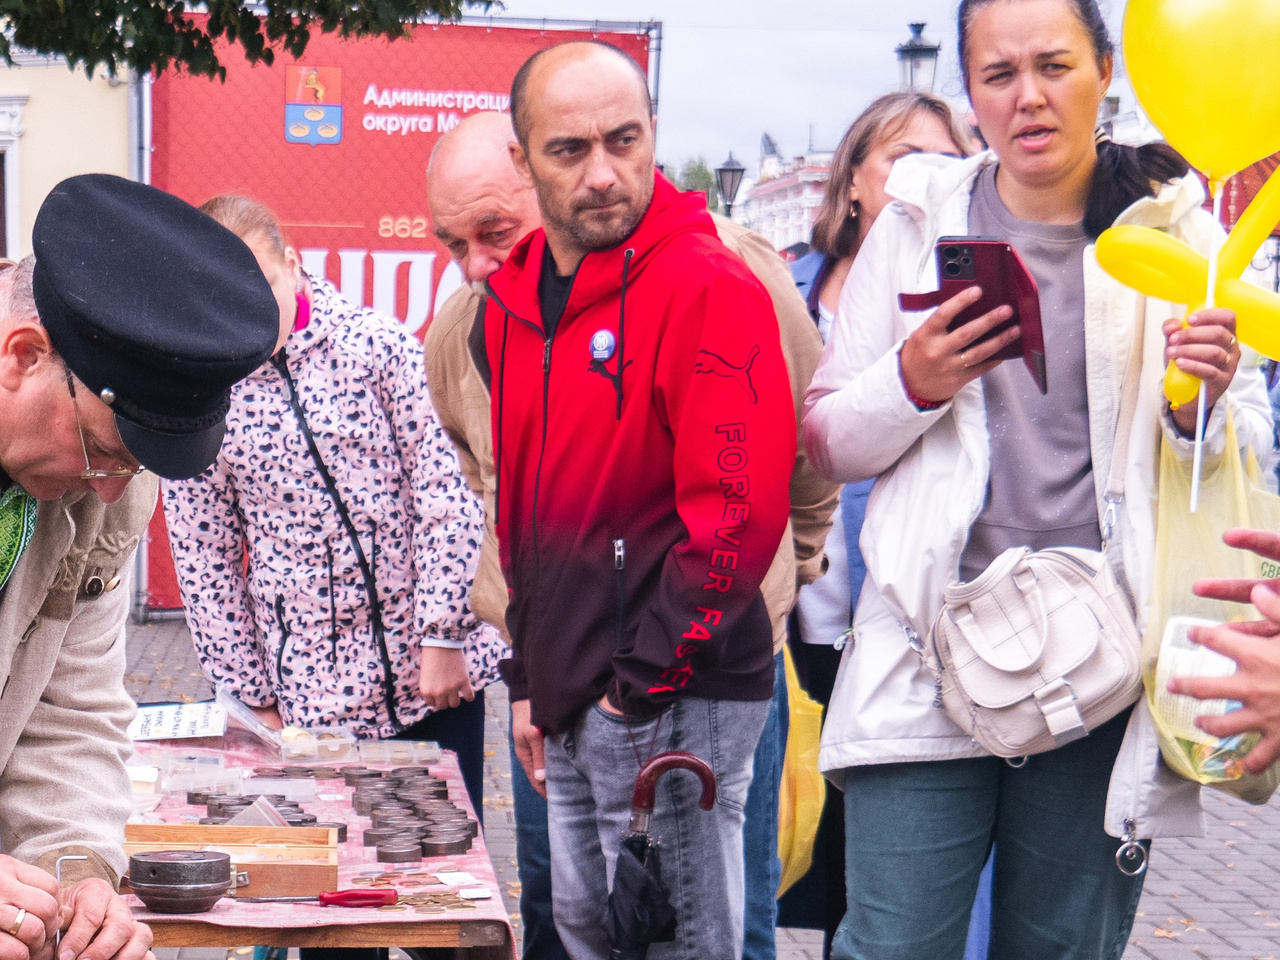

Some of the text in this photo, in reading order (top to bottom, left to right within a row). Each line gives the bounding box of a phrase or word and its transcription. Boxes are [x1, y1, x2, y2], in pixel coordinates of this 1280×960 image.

[363, 85, 511, 113] Администраци
[362, 113, 433, 136] округа
[378, 217, 427, 238] 862
[703, 422, 751, 594] FOREVER
